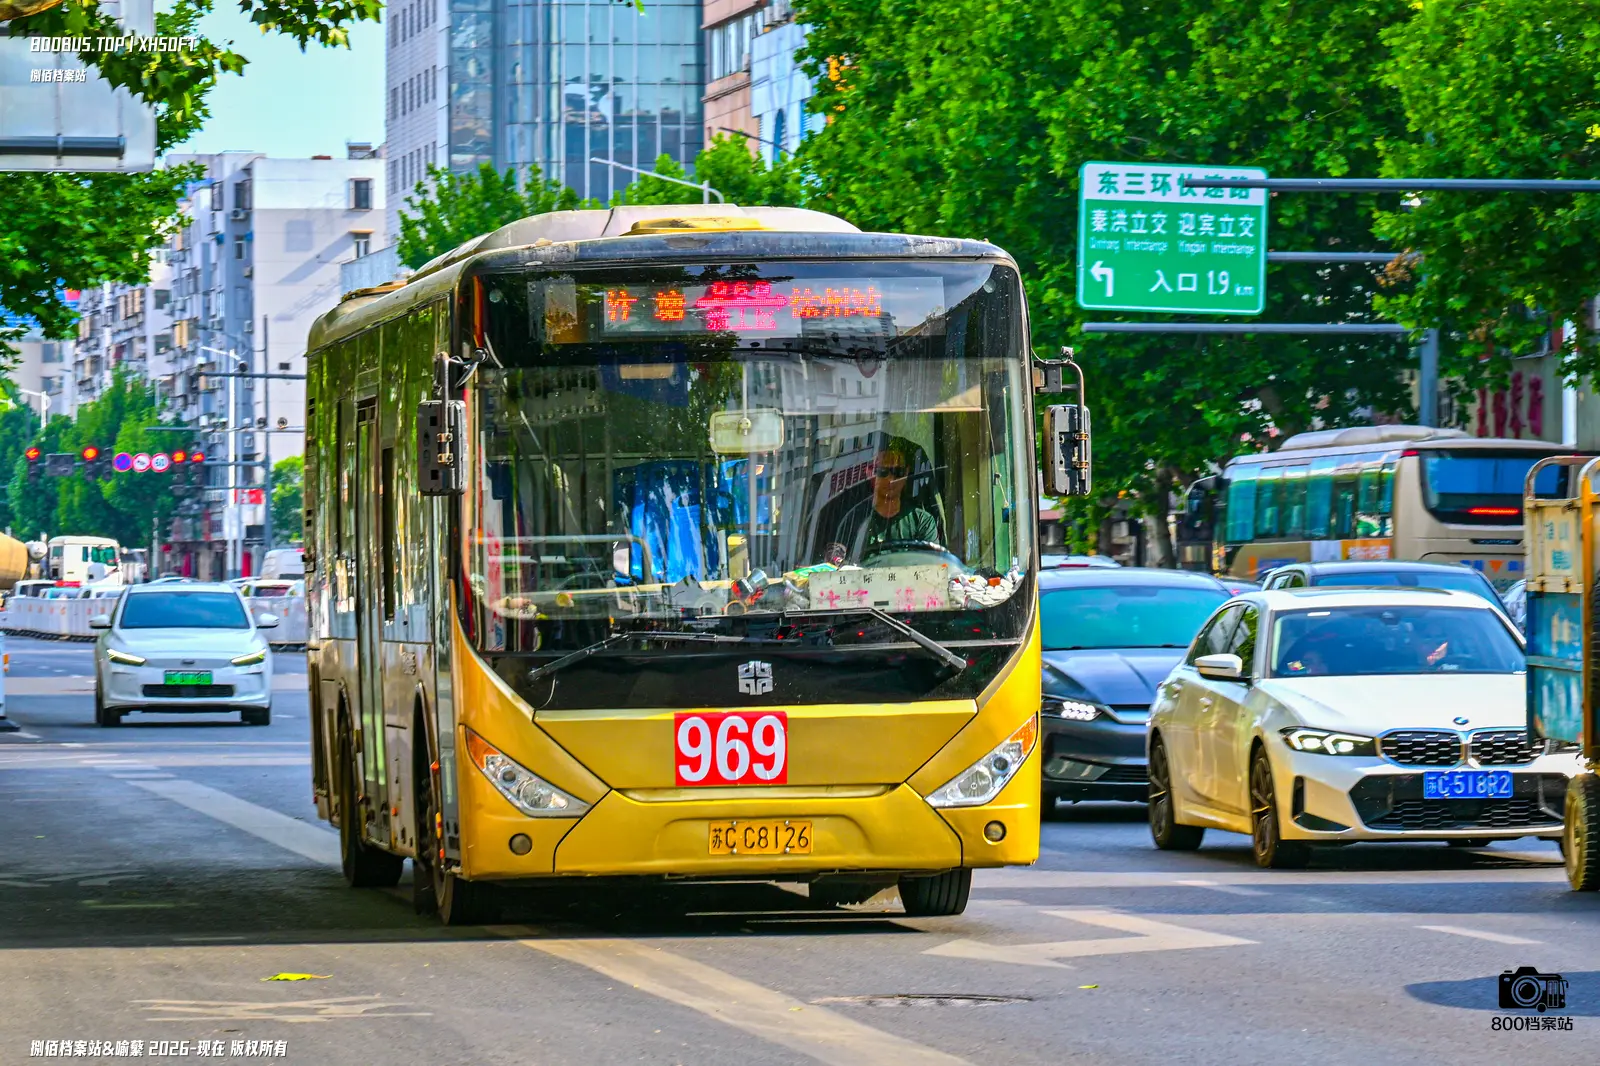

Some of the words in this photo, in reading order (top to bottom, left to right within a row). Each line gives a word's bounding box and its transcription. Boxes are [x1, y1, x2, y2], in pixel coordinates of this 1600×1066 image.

[1097, 170, 1251, 199] 东三环快速路
[1178, 211, 1255, 238] 迎宾立交
[1148, 269, 1198, 292] 入口
[677, 715, 786, 782] 969
